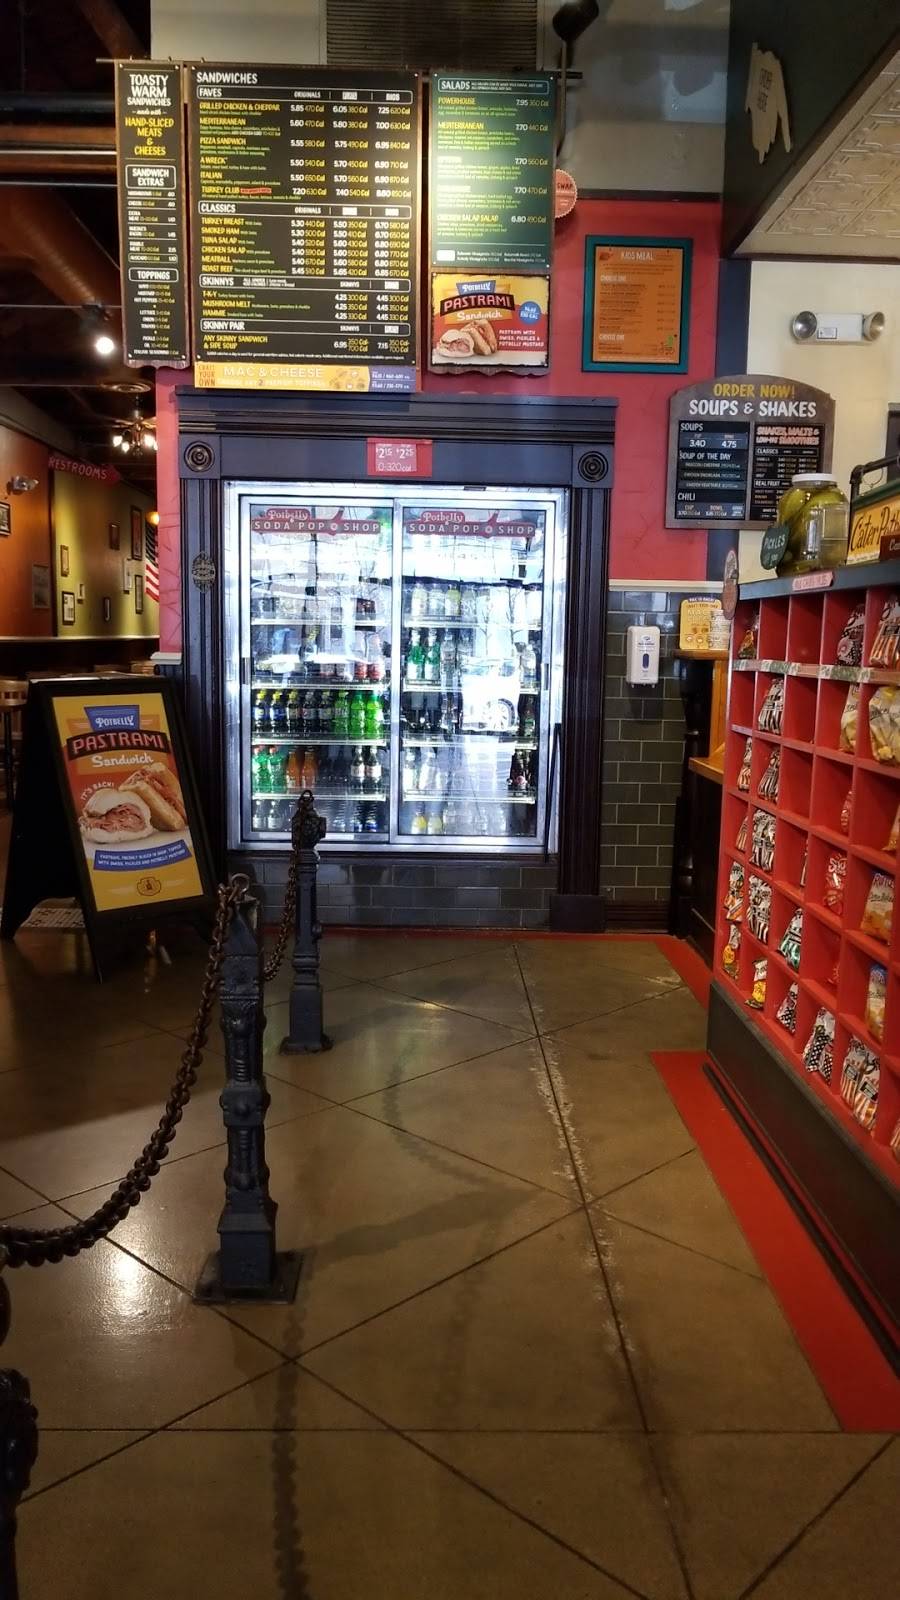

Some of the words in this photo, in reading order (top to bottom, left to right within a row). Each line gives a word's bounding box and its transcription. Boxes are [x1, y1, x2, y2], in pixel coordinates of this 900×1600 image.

[129, 74, 168, 86] TOASTY
[196, 72, 258, 84] SANDWICHES
[441, 80, 470, 90] SALADS
[131, 86, 167, 98] WARM
[200, 88, 222, 97] FAVES
[127, 97, 171, 106] SANDWICHES
[438, 97, 476, 105] POWERHOUSE
[125, 117, 174, 127] HAND-SLICED
[137, 128, 162, 137] MEATS
[134, 146, 166, 156] CHEESES
[132, 168, 169, 178] SANDWICH
[137, 178, 164, 187] EXTRAS
[224, 186, 240, 194] CLUB
[201, 203, 236, 213] CLASSICS
[202, 217, 223, 225] TURKEY
[227, 246, 246, 254] SALAD
[137, 270, 170, 280] TOPPINGS
[202, 277, 234, 286] SKINNYS
[462, 282, 491, 292] POTBELLY
[236, 300, 251, 308] MELT
[444, 295, 511, 312] PASTRAMI
[457, 310, 502, 321] Sandwich
[203, 321, 229, 330] SKINNY
[229, 322, 245, 330] PAIR
[238, 335, 268, 343] SANDWICH
[334, 341, 347, 349] 6.95
[224, 366, 254, 376] MAC
[259, 367, 266, 377] &
[270, 367, 322, 378] CHEESE
[198, 379, 215, 387] OWN
[713, 383, 755, 397] ORDER
[760, 384, 795, 398] NOW!
[689, 399, 738, 416] SOUPS
[743, 403, 754, 414] &
[759, 401, 816, 417] SHAKES
[680, 423, 703, 431] SOUPS
[679, 452, 696, 460] SOUP
[48, 456, 107, 479] RESTROOMS
[677, 493, 696, 501] CHILI
[268, 510, 308, 520] Potbelly
[423, 511, 463, 522] Potbelly
[254, 521, 290, 530] SODA
[298, 522, 324, 531] POP
[344, 523, 379, 531] SHOP
[409, 523, 445, 532] SODA
[453, 524, 479, 532] POP
[498, 524, 534, 533] SHOP
[95, 715, 135, 728] POTBELLY
[73, 732, 164, 754] PASTRAMI
[91, 753, 154, 768] Sandwich
